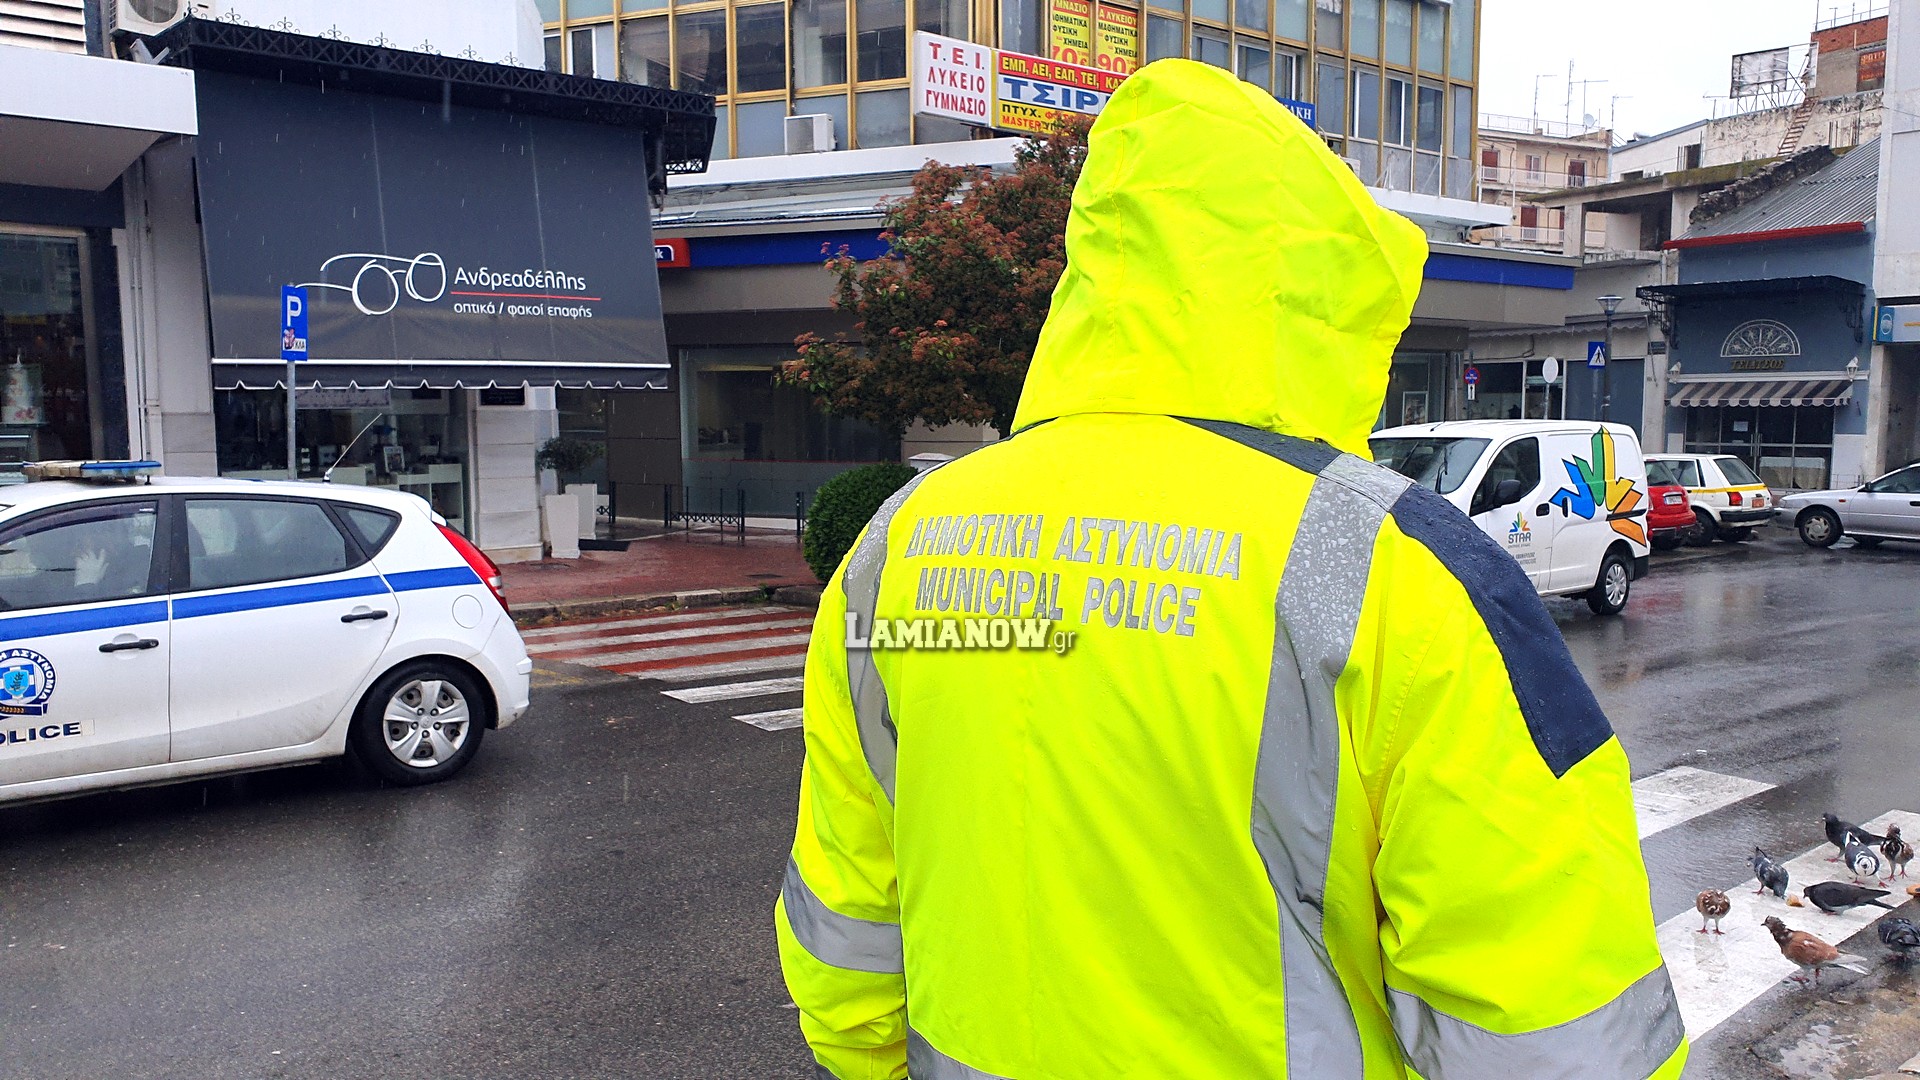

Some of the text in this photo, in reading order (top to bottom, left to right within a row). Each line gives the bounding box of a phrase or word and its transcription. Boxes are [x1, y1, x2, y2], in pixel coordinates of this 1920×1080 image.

[1053, 13, 1088, 28] ΘΗΜΑΤΙΚΑ
[1053, 25, 1078, 36] ΦΥΣΙΚΗ
[1063, 37, 1088, 49] ΧΗΜΕΙΑ
[1104, 35, 1129, 46] ΦΥΣΙΚΗ
[928, 66, 985, 93] ΛΥΚΕΙΟ
[1002, 57, 1029, 74] ΕΜΠ,
[1032, 62, 1052, 80] ΑΕΙ,
[1055, 67, 1078, 84] ΕΑΠ,
[1081, 71, 1100, 88] ΤΕΙ,
[926, 89, 986, 117] ΓΥΜΝΑΣΙΟ
[1003, 77, 1110, 110] ΤΣΙΡ
[1002, 104, 1042, 118] ΠΤΥΧ.
[454, 267, 587, 291] Ανδρεαδέλλης
[287, 295, 302, 327] P
[454, 302, 496, 314] οπτικά
[507, 303, 544, 317] φακοί
[547, 305, 592, 320] επαφής
[904, 513, 1242, 580] ΔΗΜΟΤΙΚΗ ΑΣΤΥΝΟΜΙΑ
[915, 567, 1201, 637] MUNICIPAL POLICE
[12, 649, 55, 700] ΑΣΤΥΝΟΜΙΑ
